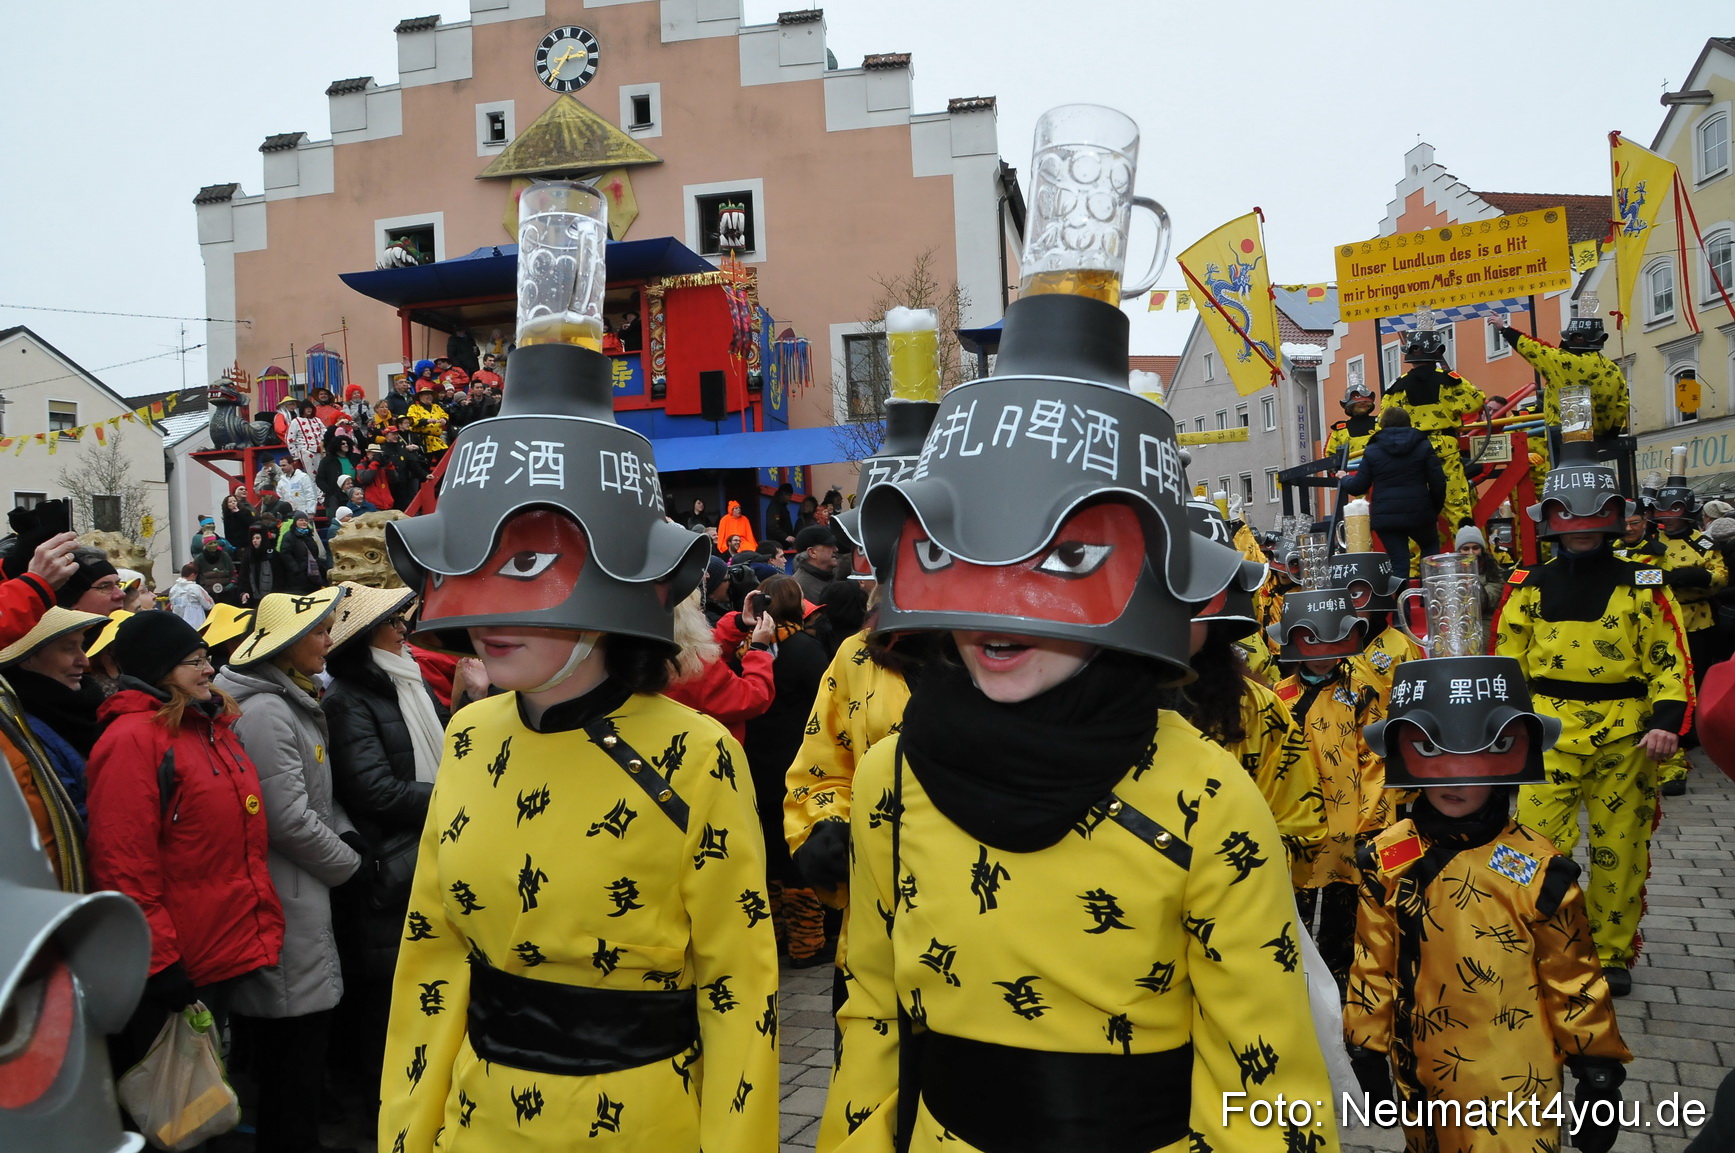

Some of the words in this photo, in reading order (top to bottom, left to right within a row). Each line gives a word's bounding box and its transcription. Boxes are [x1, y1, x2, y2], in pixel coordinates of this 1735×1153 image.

[1352, 263, 1387, 277] Unser
[1392, 252, 1446, 271] Lundlum
[1449, 246, 1472, 262] des
[1478, 243, 1490, 257] is
[1493, 243, 1503, 255] a
[1506, 235, 1528, 252] Hit
[1343, 288, 1365, 302] mir
[1367, 284, 1406, 300] bringa
[1407, 280, 1431, 292] vom
[1466, 271, 1481, 284] an
[1483, 265, 1523, 281] Kaiser
[1526, 257, 1548, 275] mit
[1297, 405, 1306, 449] UHREN
